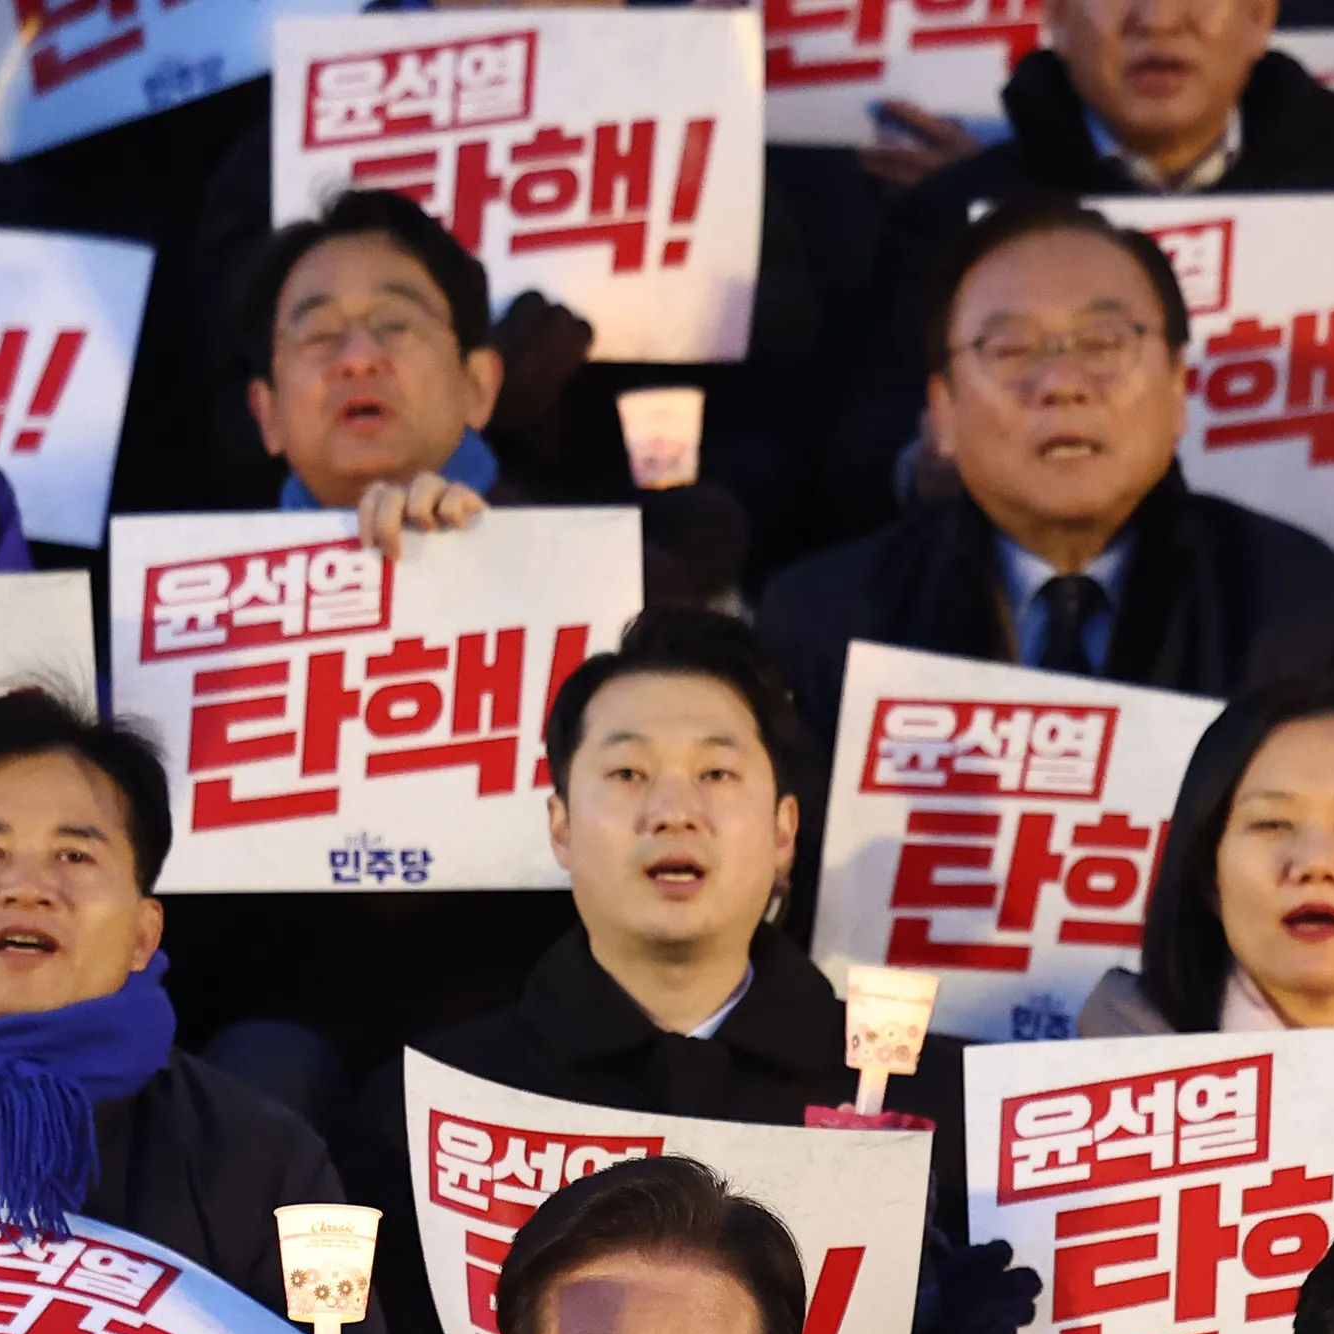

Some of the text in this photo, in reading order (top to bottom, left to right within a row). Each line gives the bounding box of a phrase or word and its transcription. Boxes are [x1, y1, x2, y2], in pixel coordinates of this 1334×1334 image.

[310, 38, 528, 140] 윤석열
[153, 547, 383, 650] 윤석열
[877, 704, 1109, 793] 윤석열
[330, 847, 435, 884] 민주당
[1011, 1066, 1259, 1191] 윤석열
[310, 1221, 356, 1235] Classic
